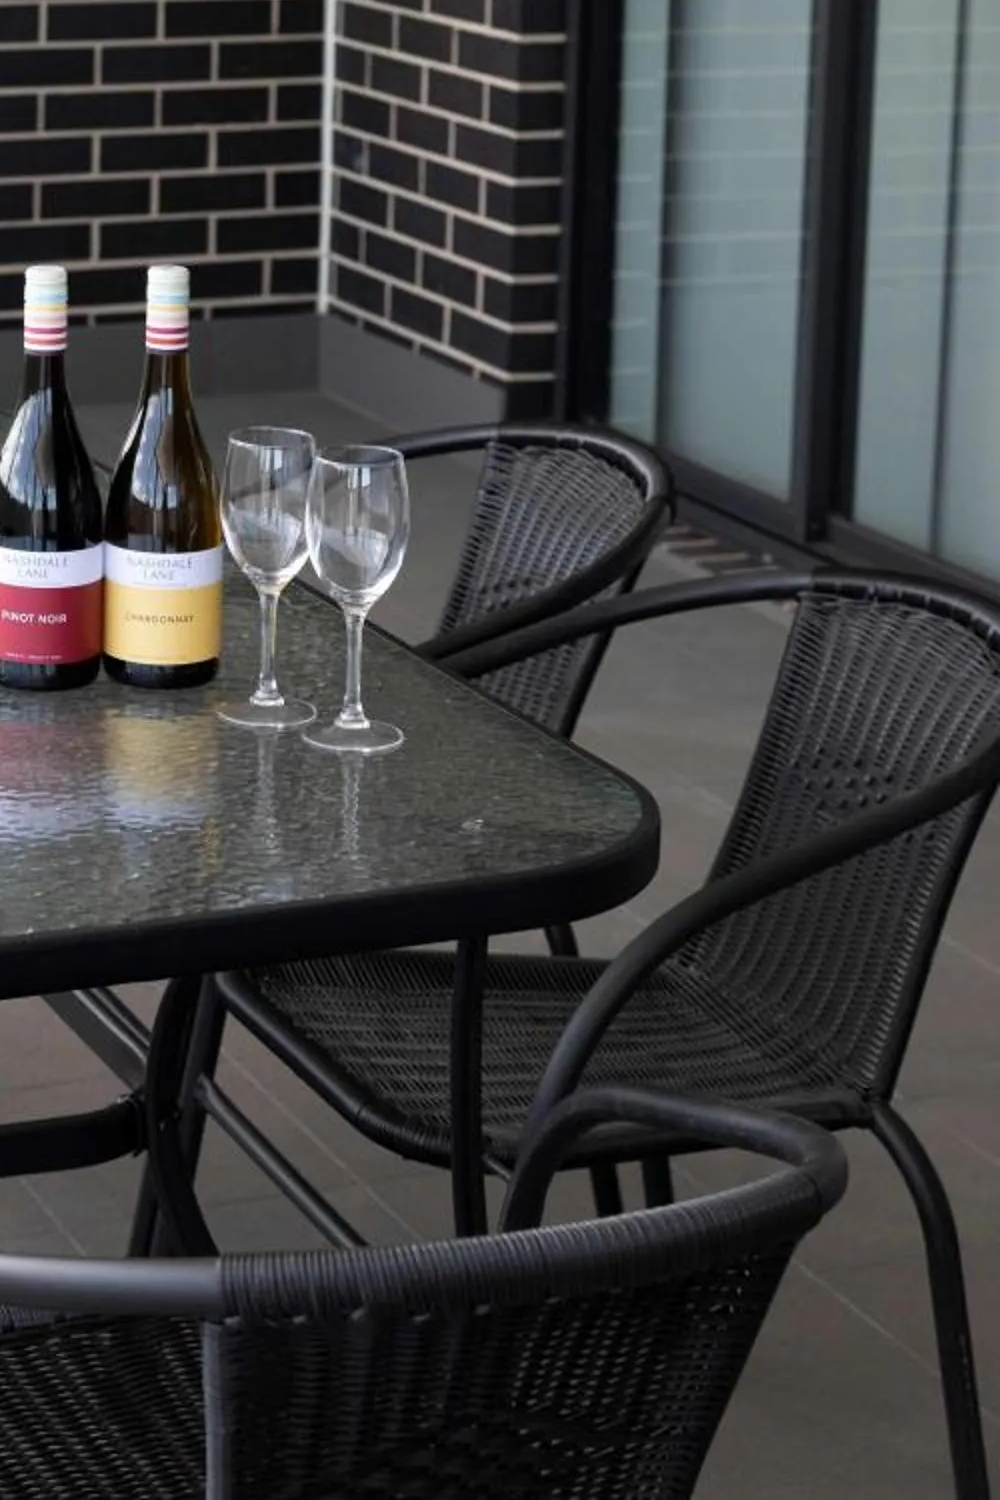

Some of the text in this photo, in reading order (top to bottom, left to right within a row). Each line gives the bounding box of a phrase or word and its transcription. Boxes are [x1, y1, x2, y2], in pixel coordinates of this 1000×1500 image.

[1, 609, 67, 624] PINOT NOIR
[124, 611, 195, 625] CHARDONNAY
